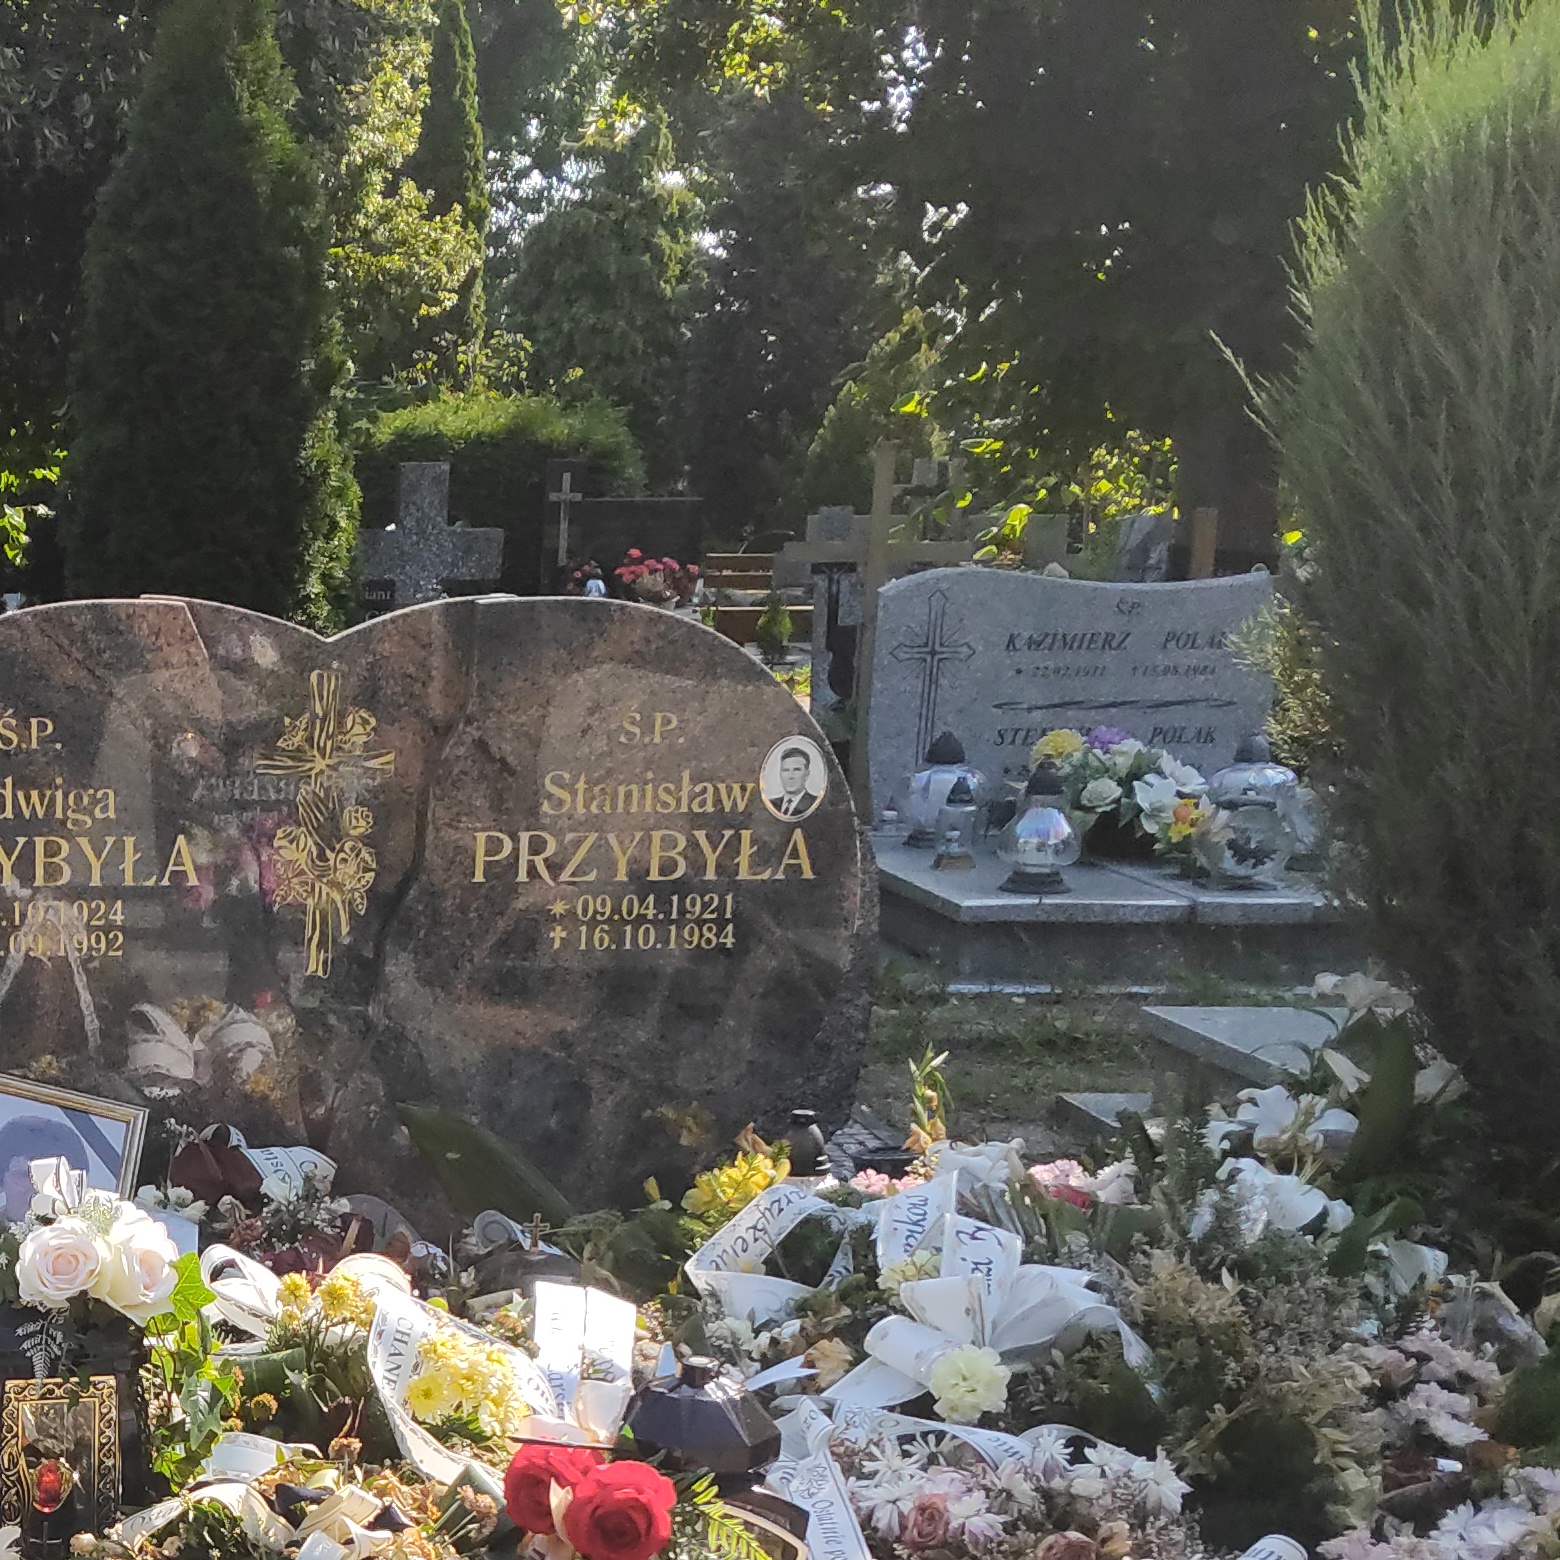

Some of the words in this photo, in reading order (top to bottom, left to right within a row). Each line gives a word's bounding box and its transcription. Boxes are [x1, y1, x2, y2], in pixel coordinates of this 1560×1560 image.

[1004, 630, 1133, 651] KAZIMIERZ
[1147, 726, 1217, 746] POLAK
[540, 768, 756, 815] Stanisław
[470, 827, 817, 887] PRZYBYŁA
[575, 893, 734, 922] 09.04.1921
[578, 922, 736, 951] 16.10.1984
